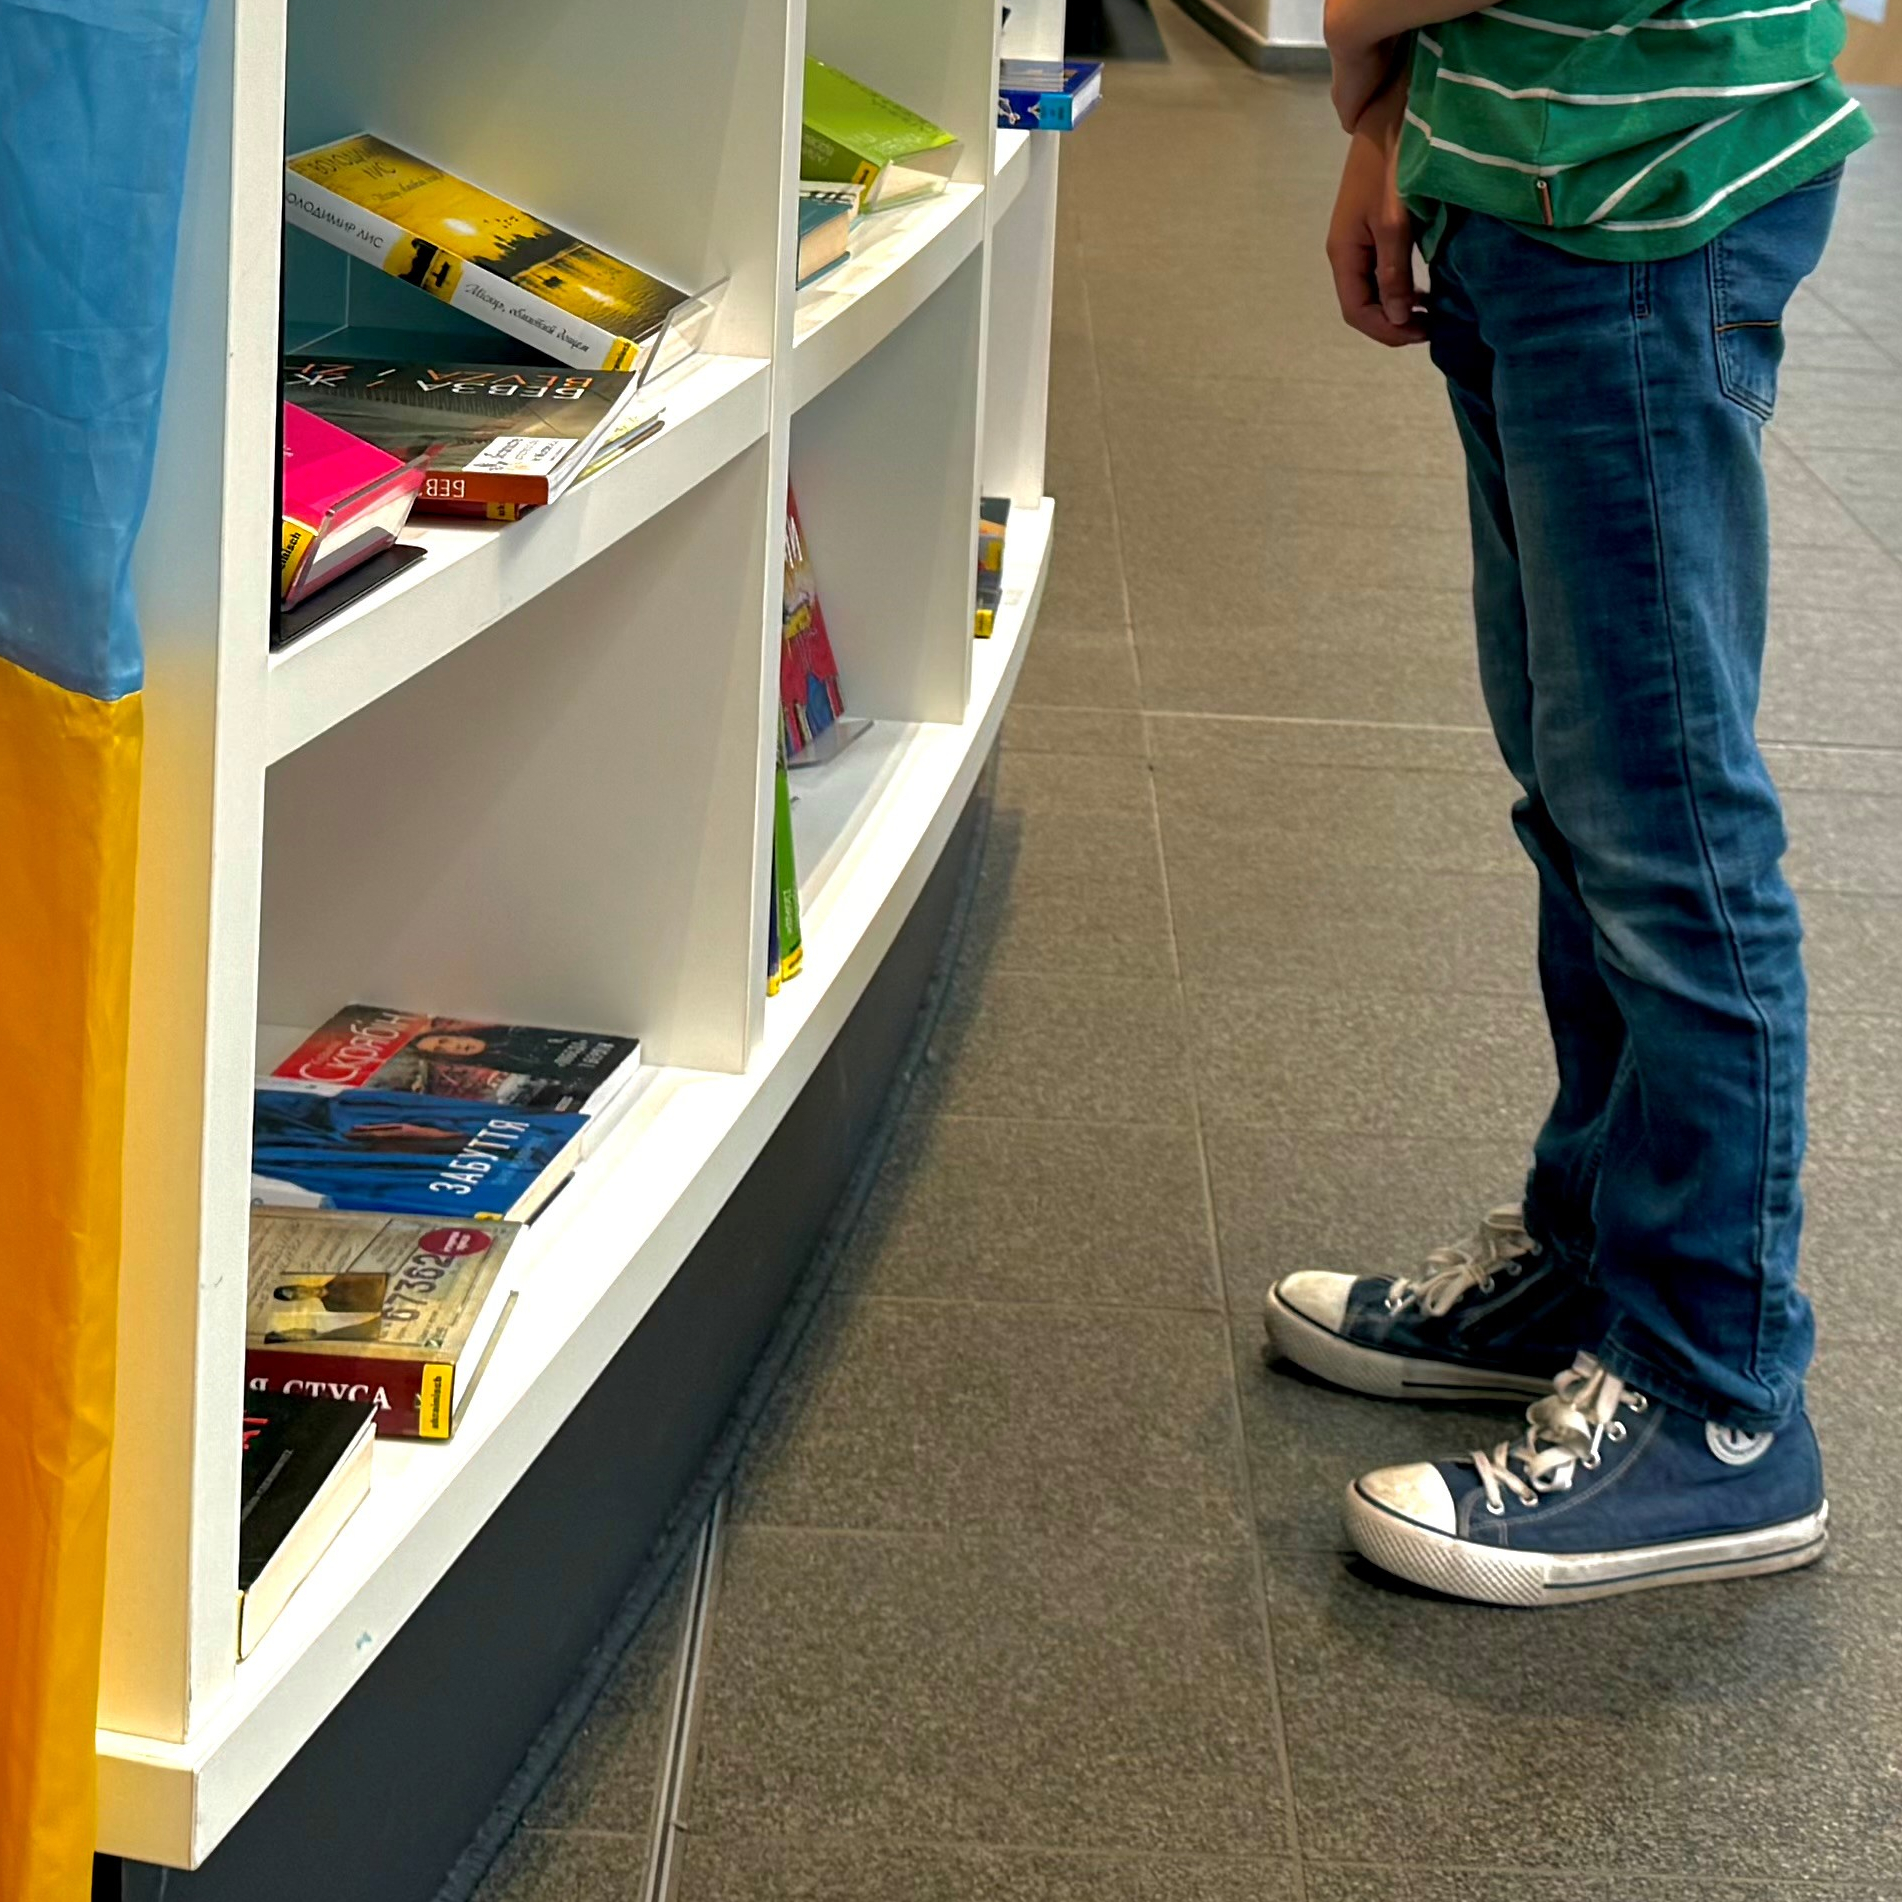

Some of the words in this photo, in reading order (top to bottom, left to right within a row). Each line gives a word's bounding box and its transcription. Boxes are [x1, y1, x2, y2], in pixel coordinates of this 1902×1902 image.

[286, 192, 357, 233] ОЛОДИМИР
[356, 230, 385, 249] ЛИС
[416, 379, 586, 400] БЕВЗА
[425, 368, 594, 390] BEVZA
[417, 479, 466, 499] БЕВ
[428, 1118, 531, 1195] ЗАБУТТЯ
